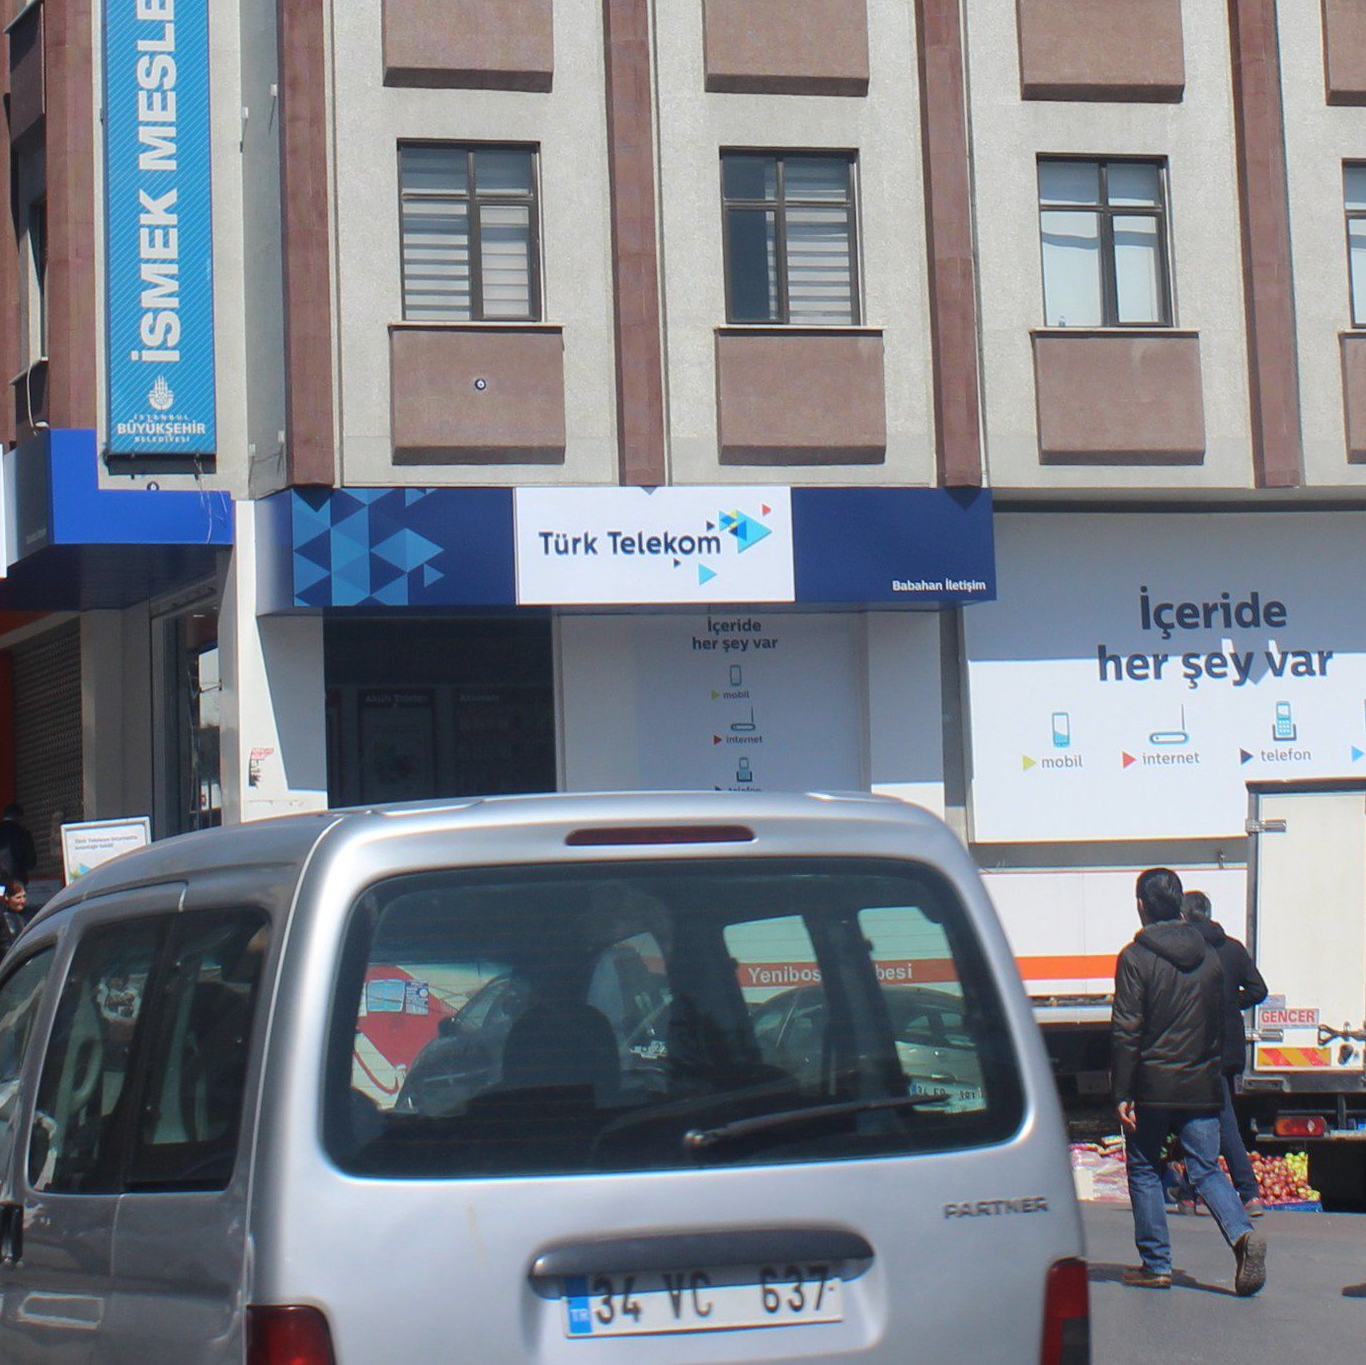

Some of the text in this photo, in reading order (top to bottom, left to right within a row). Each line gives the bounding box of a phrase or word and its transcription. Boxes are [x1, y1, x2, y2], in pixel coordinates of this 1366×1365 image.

[131, 188, 181, 363] İSMEK
[117, 419, 206, 436] BÜYÜKŞEHİR
[538, 531, 721, 555] Türk Telekom
[892, 579, 943, 591] Babahan
[1140, 585, 1287, 639] İçeride
[707, 616, 762, 635] İçeride
[692, 637, 779, 653] her şey var
[1098, 644, 1334, 689] her şey var
[723, 690, 750, 699] mobil
[1040, 754, 1084, 769] mobil
[1142, 751, 1200, 766] internet
[1260, 748, 1312, 762] telefon
[748, 963, 913, 984] Yenibos besi
[1261, 1010, 1316, 1023] GENCER
[943, 1196, 1048, 1220] PARTNER
[595, 1264, 833, 1325] 34 VC 637
[571, 1307, 590, 1323] TR
